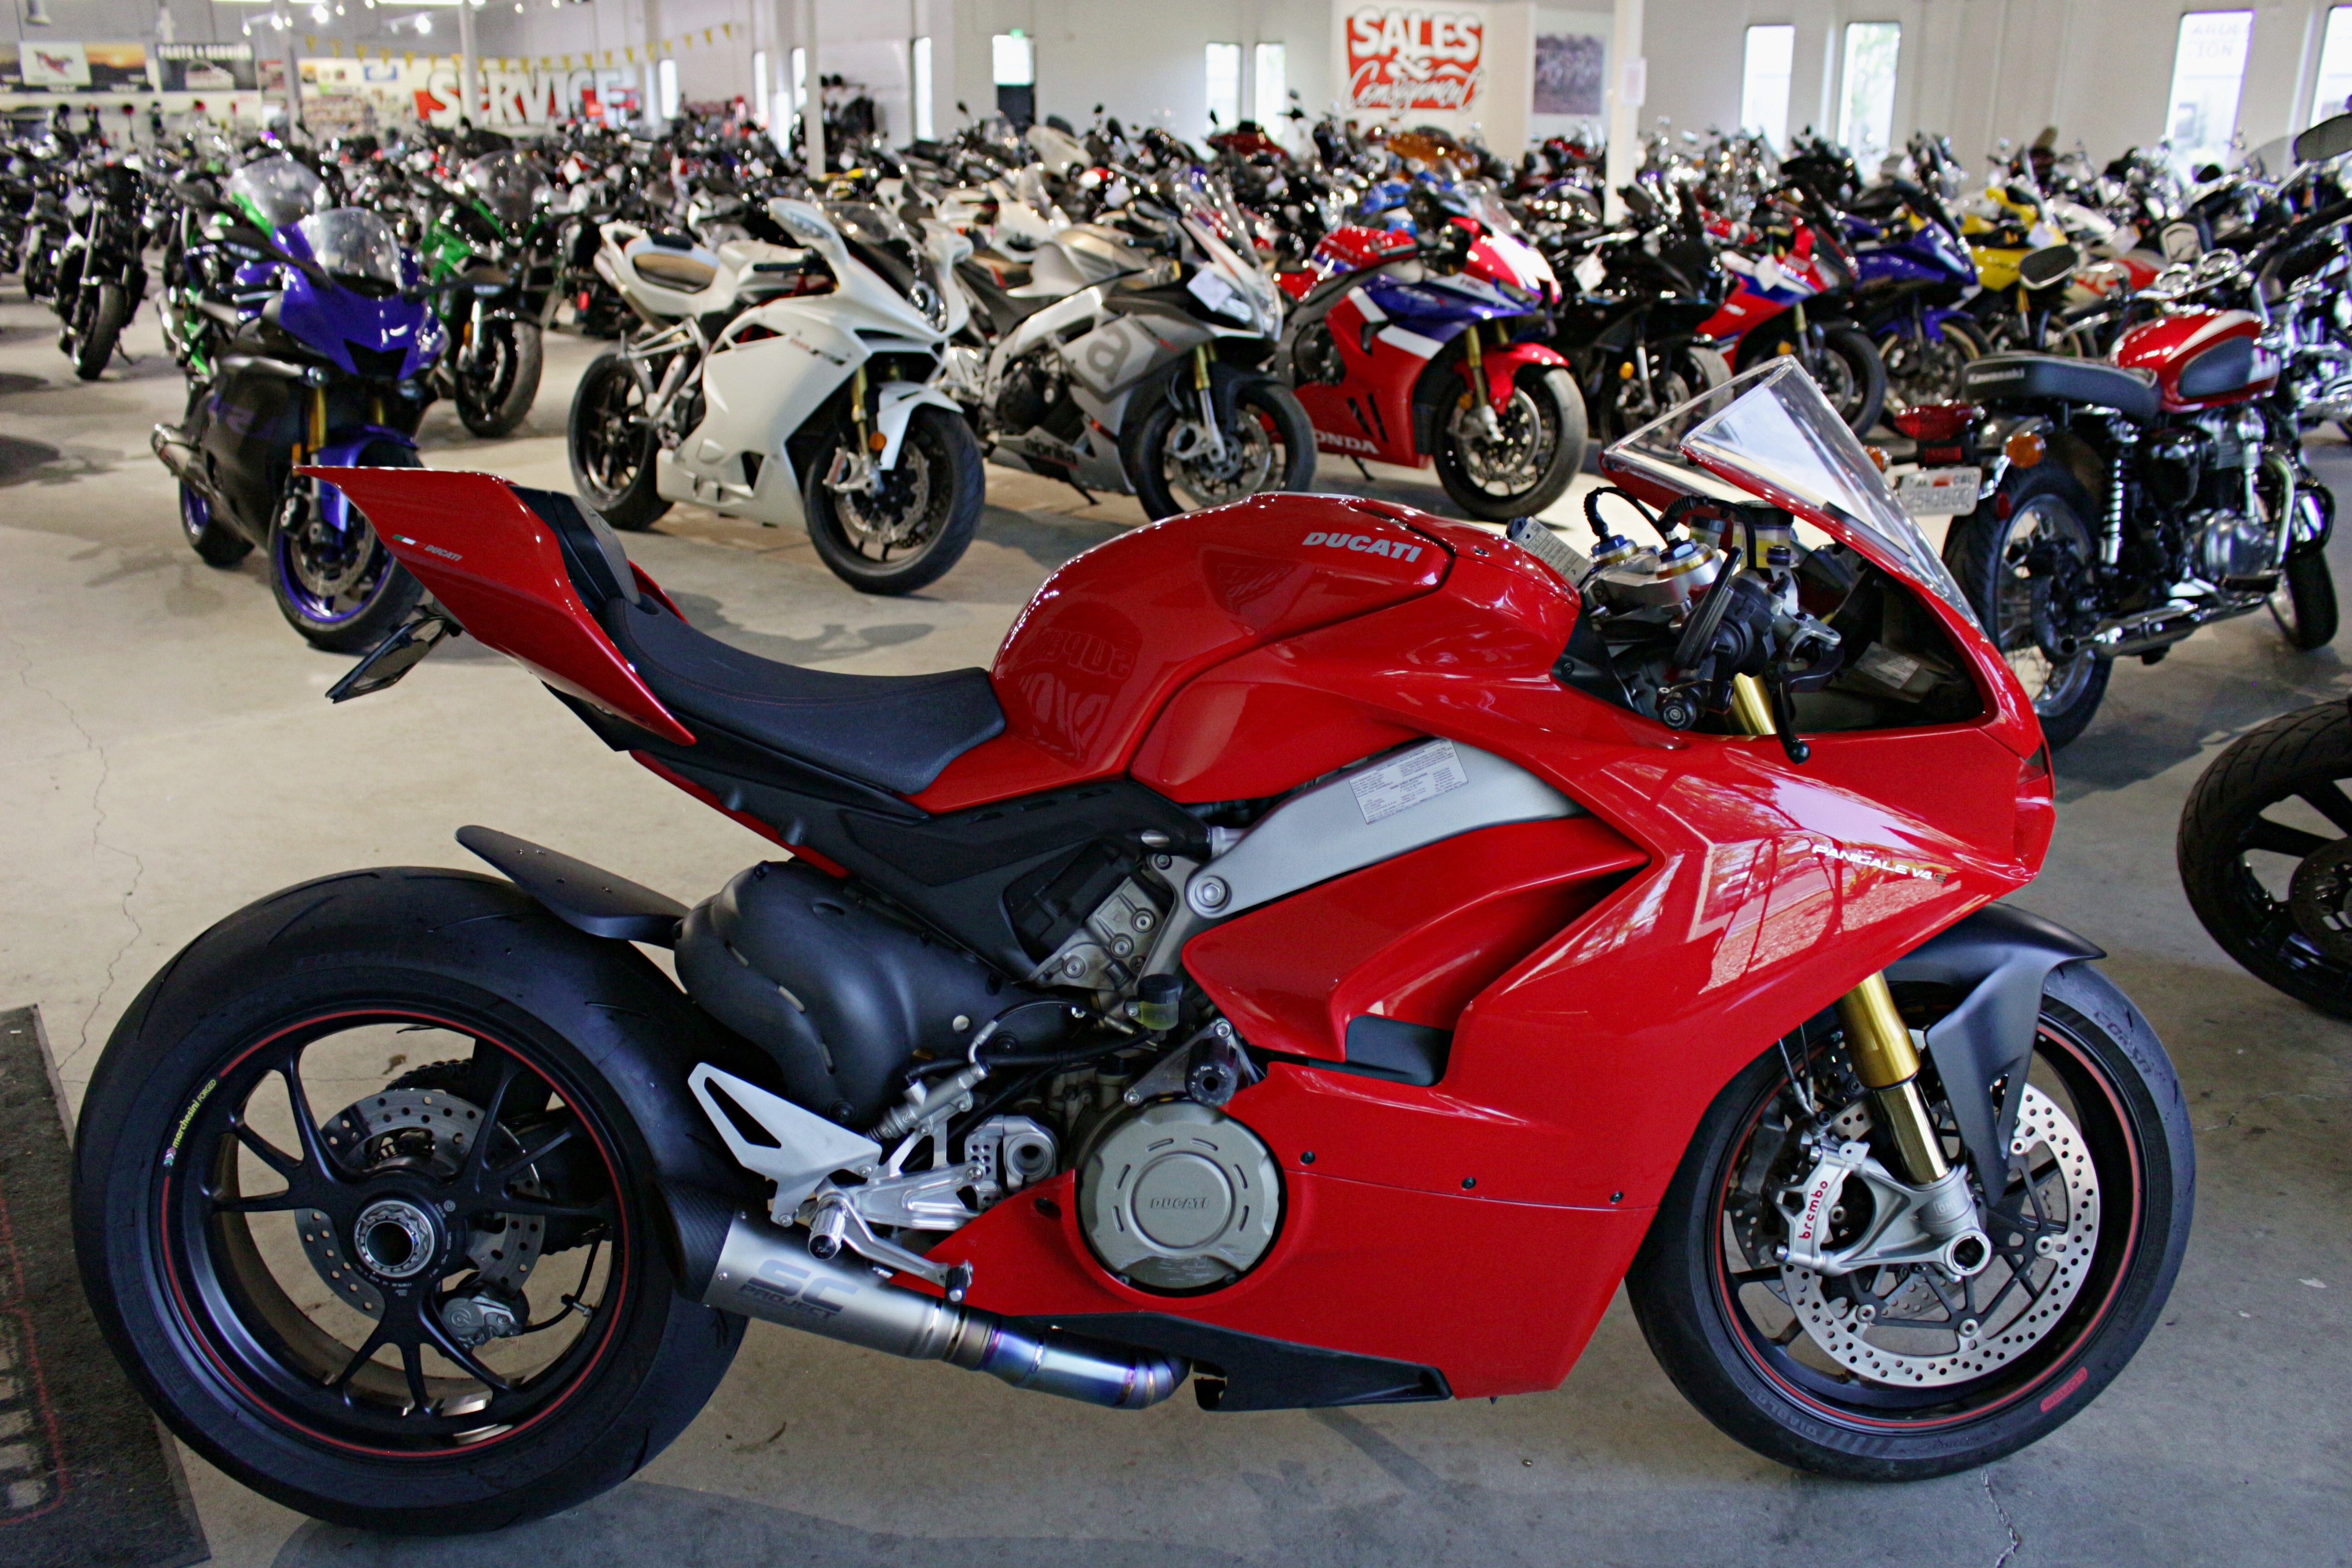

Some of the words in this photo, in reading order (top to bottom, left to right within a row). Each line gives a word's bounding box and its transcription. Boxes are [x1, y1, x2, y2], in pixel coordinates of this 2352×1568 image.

[1350, 5, 1481, 63] SALES
[1314, 430, 1381, 455] ONDA
[424, 544, 463, 562] DUCATI
[1302, 532, 1423, 563] DUCATI
[1812, 844, 1909, 875] PANIGALE
[1912, 867, 1932, 880] V4
[2093, 1010, 2152, 1075] CORSA
[172, 1099, 201, 1148] marchesini
[197, 1079, 216, 1102] FORGED
[1150, 1197, 1209, 1209] DUCATI
[1798, 1181, 1828, 1240] brembo
[737, 1284, 838, 1320] PROJECT
[747, 1259, 859, 1313] SC
[1757, 1390, 1818, 1437] DIABLO
